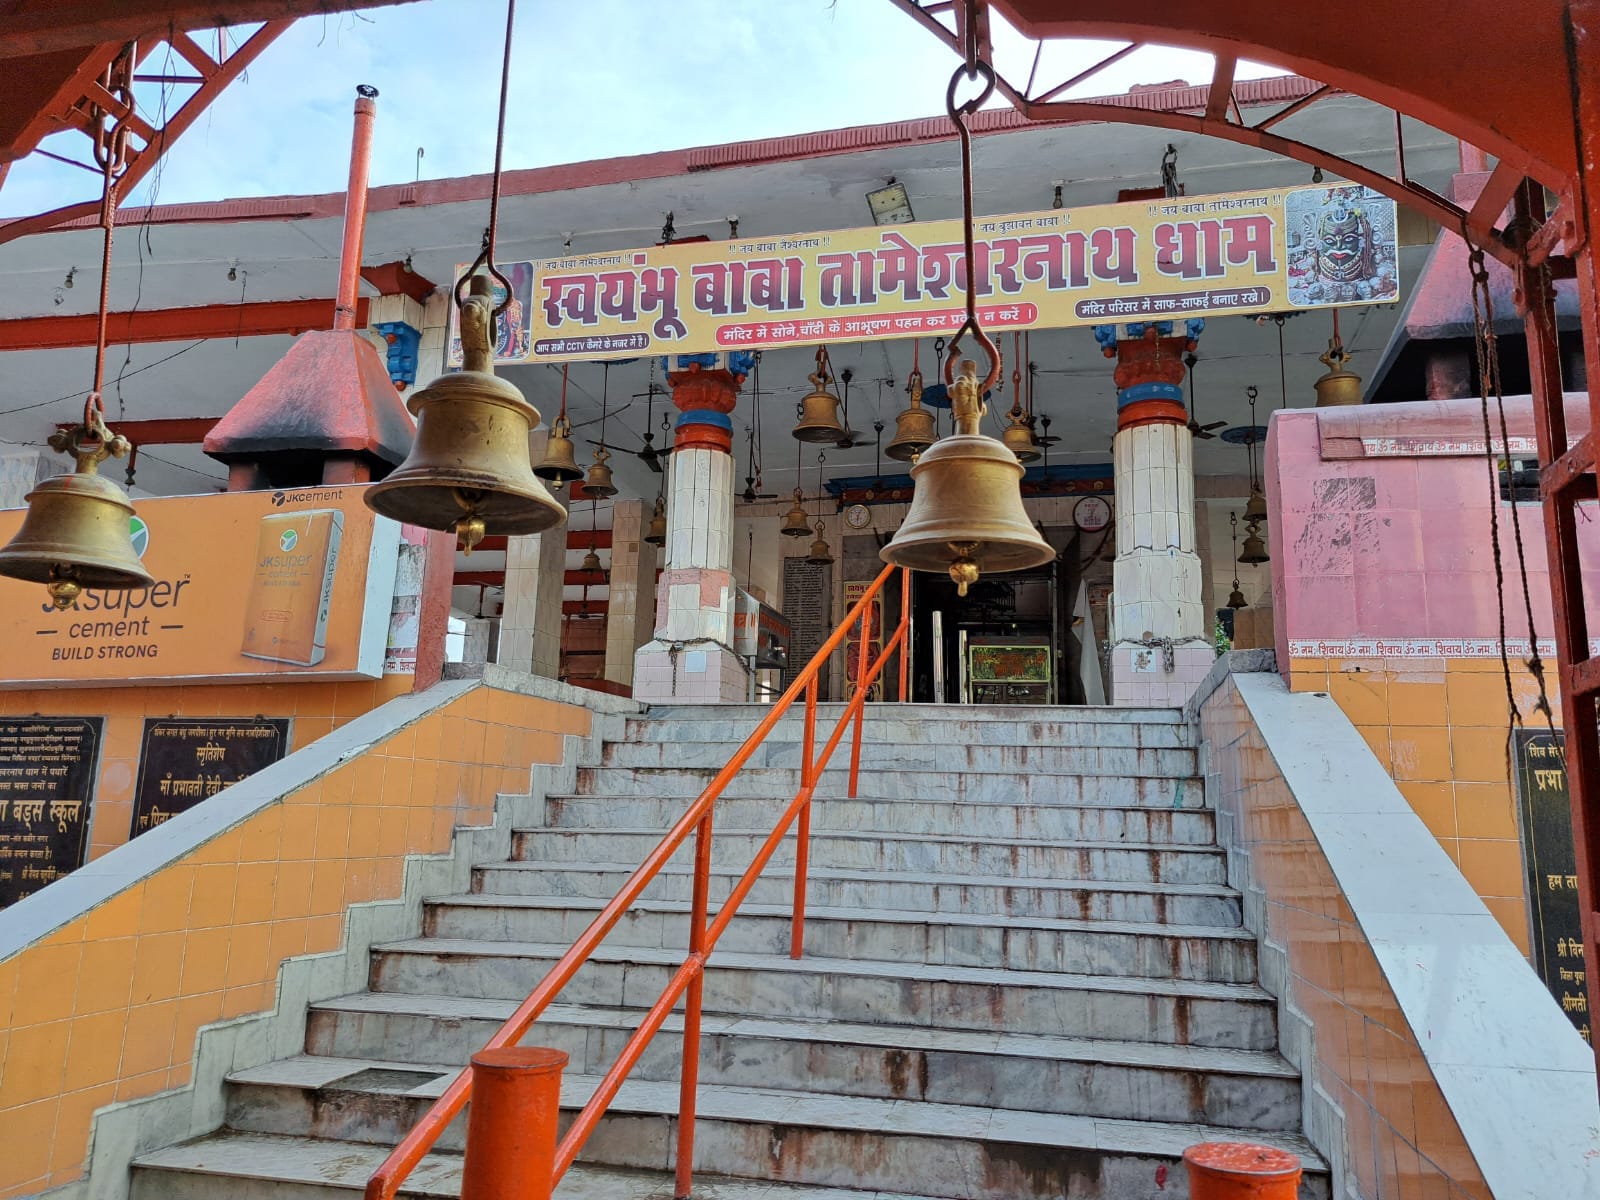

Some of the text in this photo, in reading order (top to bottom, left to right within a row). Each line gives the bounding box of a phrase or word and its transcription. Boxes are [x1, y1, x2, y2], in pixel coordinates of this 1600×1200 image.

[542, 216, 1277, 339] स्वयंभू बाबा तामेश्वरनाथ धाम
[1081, 300, 1105, 315] मंदिर
[1108, 296, 1138, 313] परिसर
[1141, 295, 1151, 311] में
[1212, 293, 1238, 306] बनाए
[723, 327, 753, 341] मंदिर
[756, 324, 767, 338] में
[828, 319, 841, 333] के
[845, 318, 891, 336] आभूषण
[894, 316, 922, 329] पहन
[926, 315, 946, 327] कर
[950, 310, 979, 325] प्रवे
[983, 311, 995, 321] न
[999, 306, 1020, 321] करें
[536, 343, 549, 353] आप
[551, 339, 565, 352] सभी
[566, 341, 585, 351] CCTV
[604, 336, 611, 349] के
[612, 339, 628, 348] नजर
[286, 490, 344, 503] JKcement
[41, 578, 191, 619] super
[69, 615, 150, 639] cement
[52, 644, 159, 661] BUILD STRONG
[1318, 641, 1344, 656] शिवाय
[1376, 641, 1402, 656] शिवाय
[1435, 641, 1462, 656] शिवाय
[197, 741, 226, 766] स्मृतिशेष
[1529, 742, 1546, 758] शिव
[160, 771, 171, 796] माँ
[173, 773, 204, 797] प्रभावती
[205, 774, 221, 796] देवी
[50, 800, 82, 833] स्कूल
[1547, 874, 1562, 890] हम
[1557, 937, 1567, 957] श्री
[1562, 990, 1587, 1012] श्रीमती
